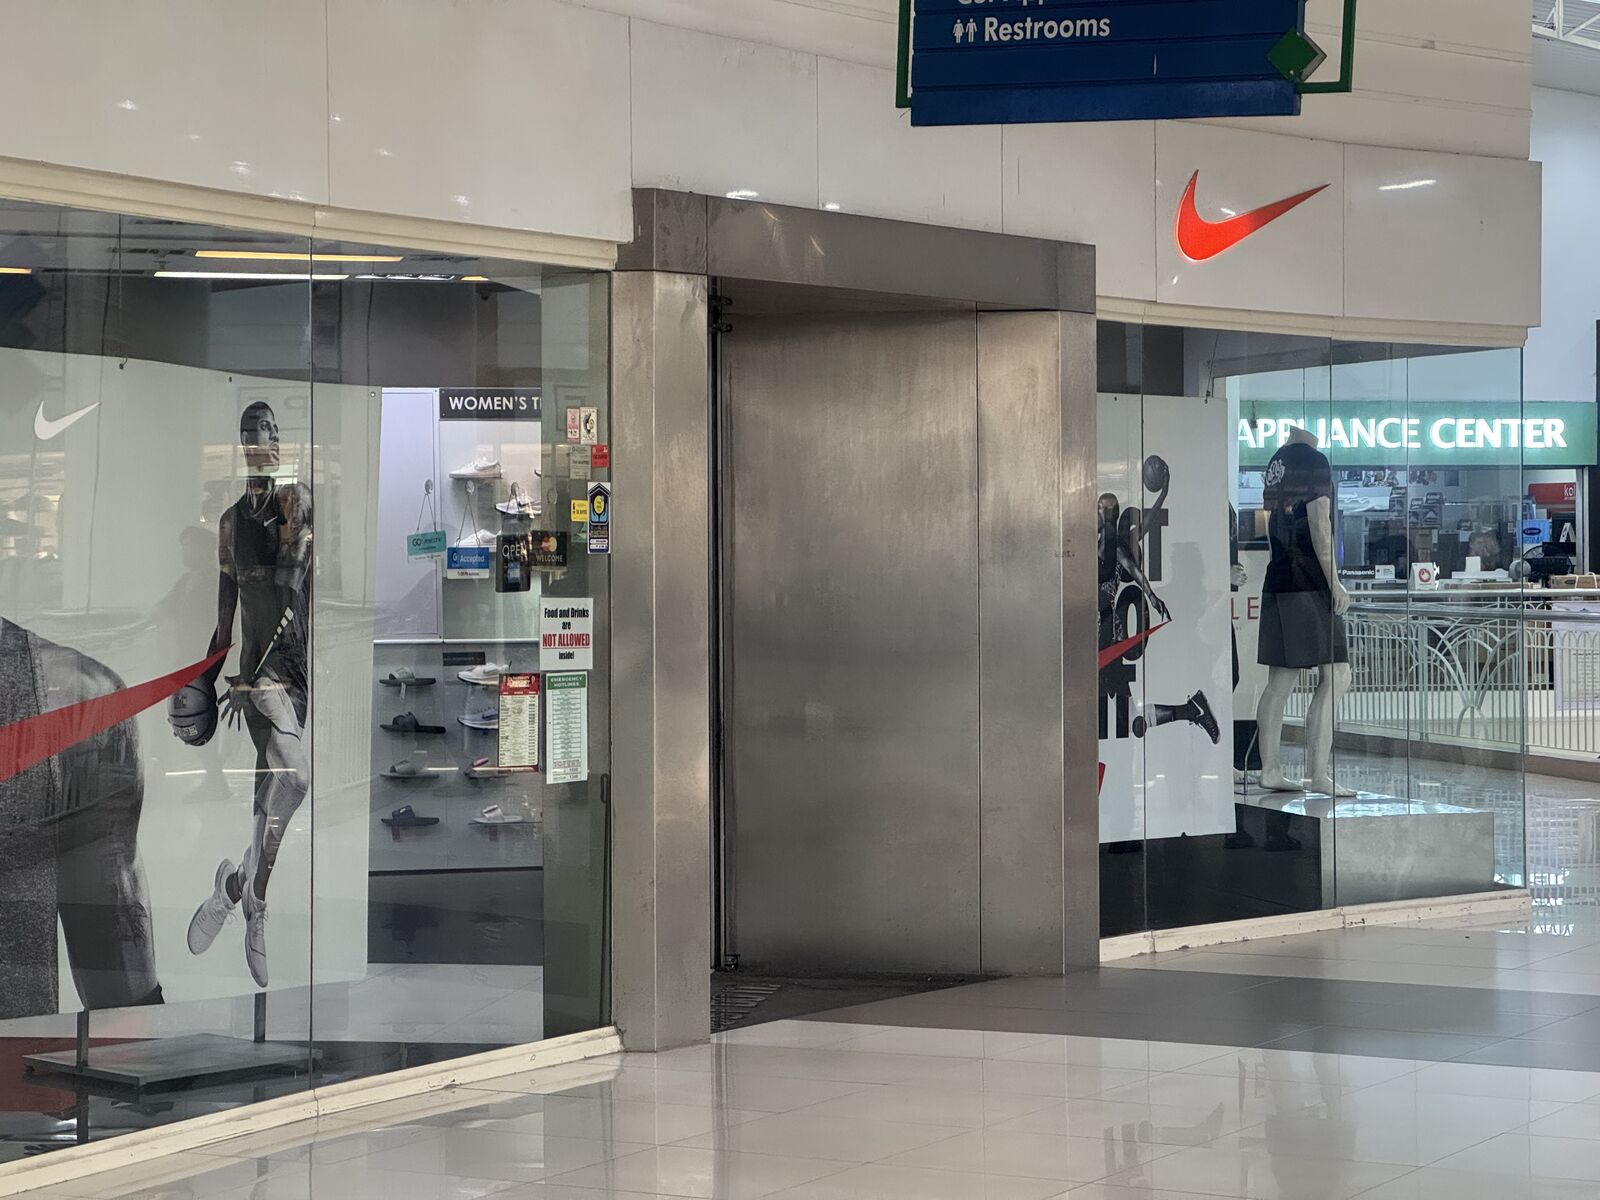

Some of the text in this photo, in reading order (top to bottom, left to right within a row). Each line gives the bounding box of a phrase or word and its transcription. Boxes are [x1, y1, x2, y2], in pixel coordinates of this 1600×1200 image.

[984, 17, 1110, 42] Restrooms
[449, 396, 542, 410] WOMEN'S T
[1238, 417, 1567, 449] APPIANCE CENTER
[460, 554, 485, 563] Accepted
[544, 607, 589, 618] Food and Drinks
[562, 621, 571, 630] are
[542, 633, 590, 647] NOT ALLOWED
